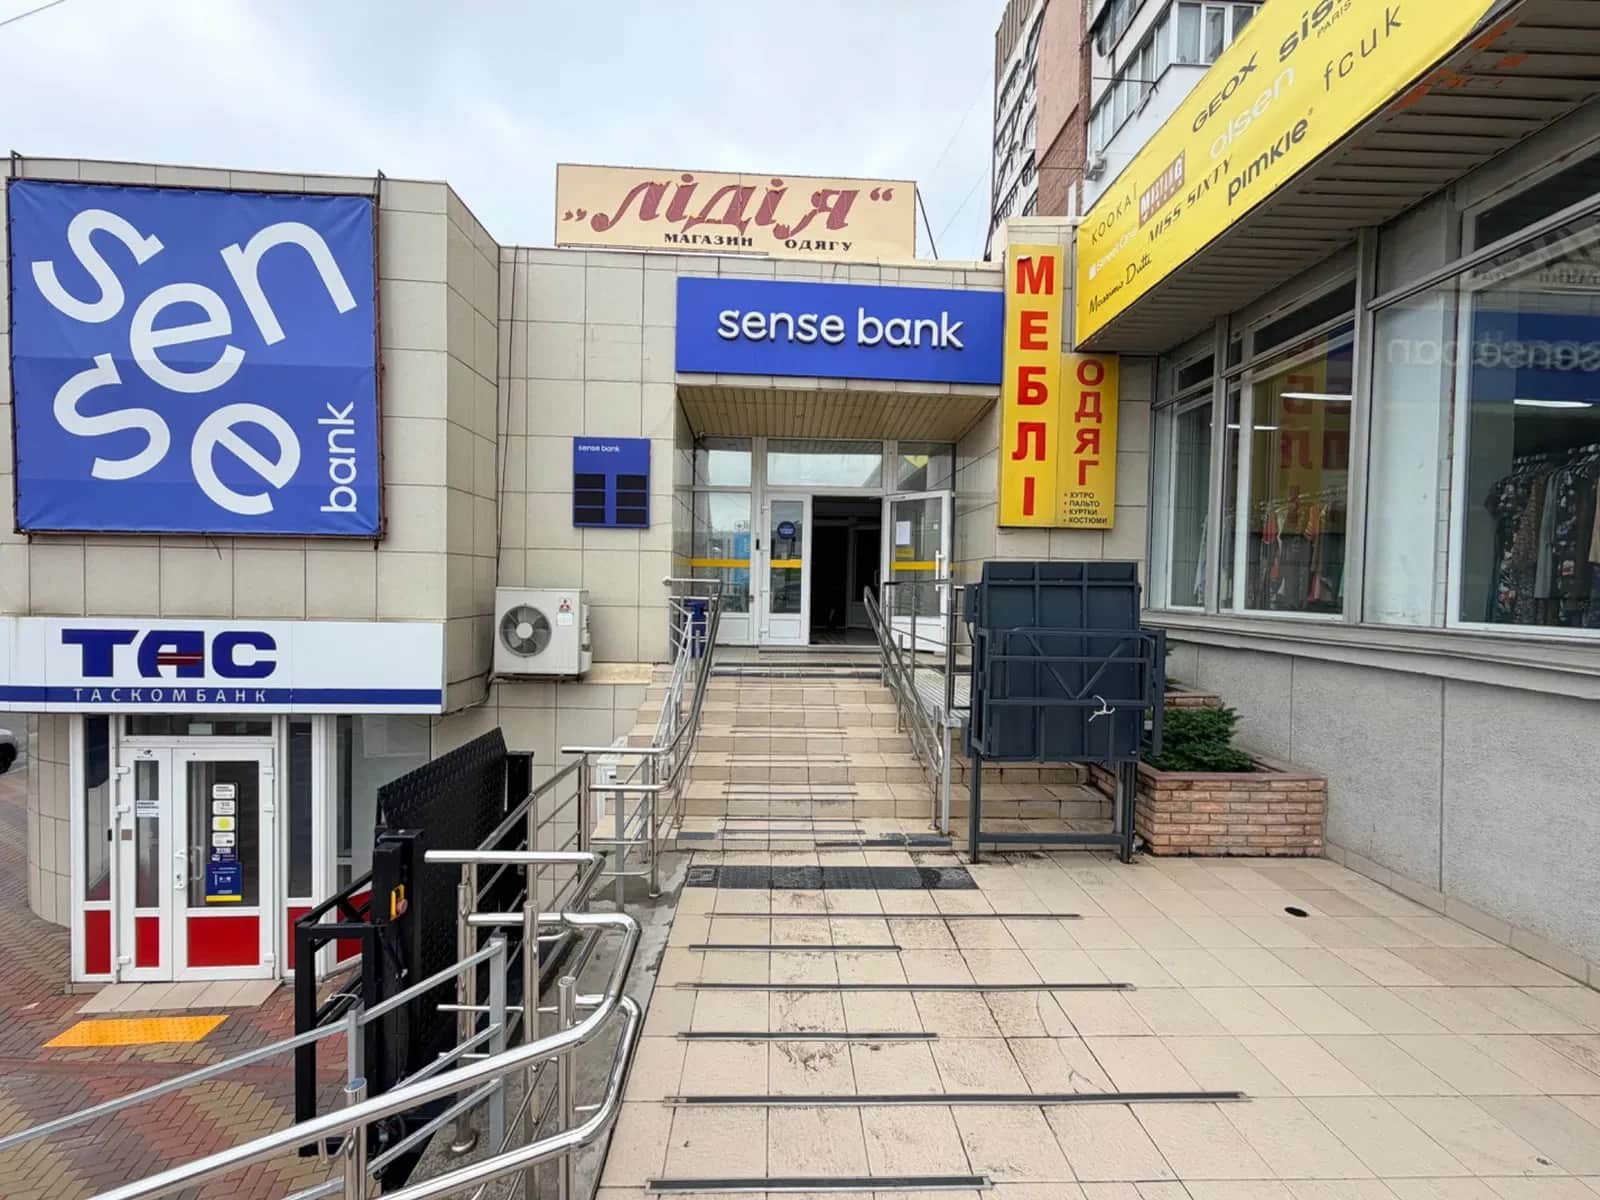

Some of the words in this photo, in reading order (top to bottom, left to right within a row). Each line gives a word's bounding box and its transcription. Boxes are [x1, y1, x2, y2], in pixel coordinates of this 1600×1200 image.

[1324, 5, 1402, 91] fcuk
[1192, 52, 1257, 133] GEOX
[1209, 65, 1295, 159] olsen
[1187, 154, 1232, 208] SIXTY
[664, 233, 753, 247] МАГАЗИН
[785, 239, 853, 251] ОДЯГУ
[717, 309, 846, 344] sense
[857, 307, 964, 349] bank
[1011, 255, 1055, 516] МЕБЛІ
[1074, 358, 1105, 486] ОДЯГ
[318, 401, 357, 512] bank
[578, 444, 600, 452] sense
[601, 444, 620, 453] bank
[1069, 500, 1101, 508] ПАЛЬТО
[1069, 516, 1108, 524] КОСТЮМИ
[61, 628, 278, 679] ТАС
[73, 688, 266, 703] ТАСКОМБАНК
